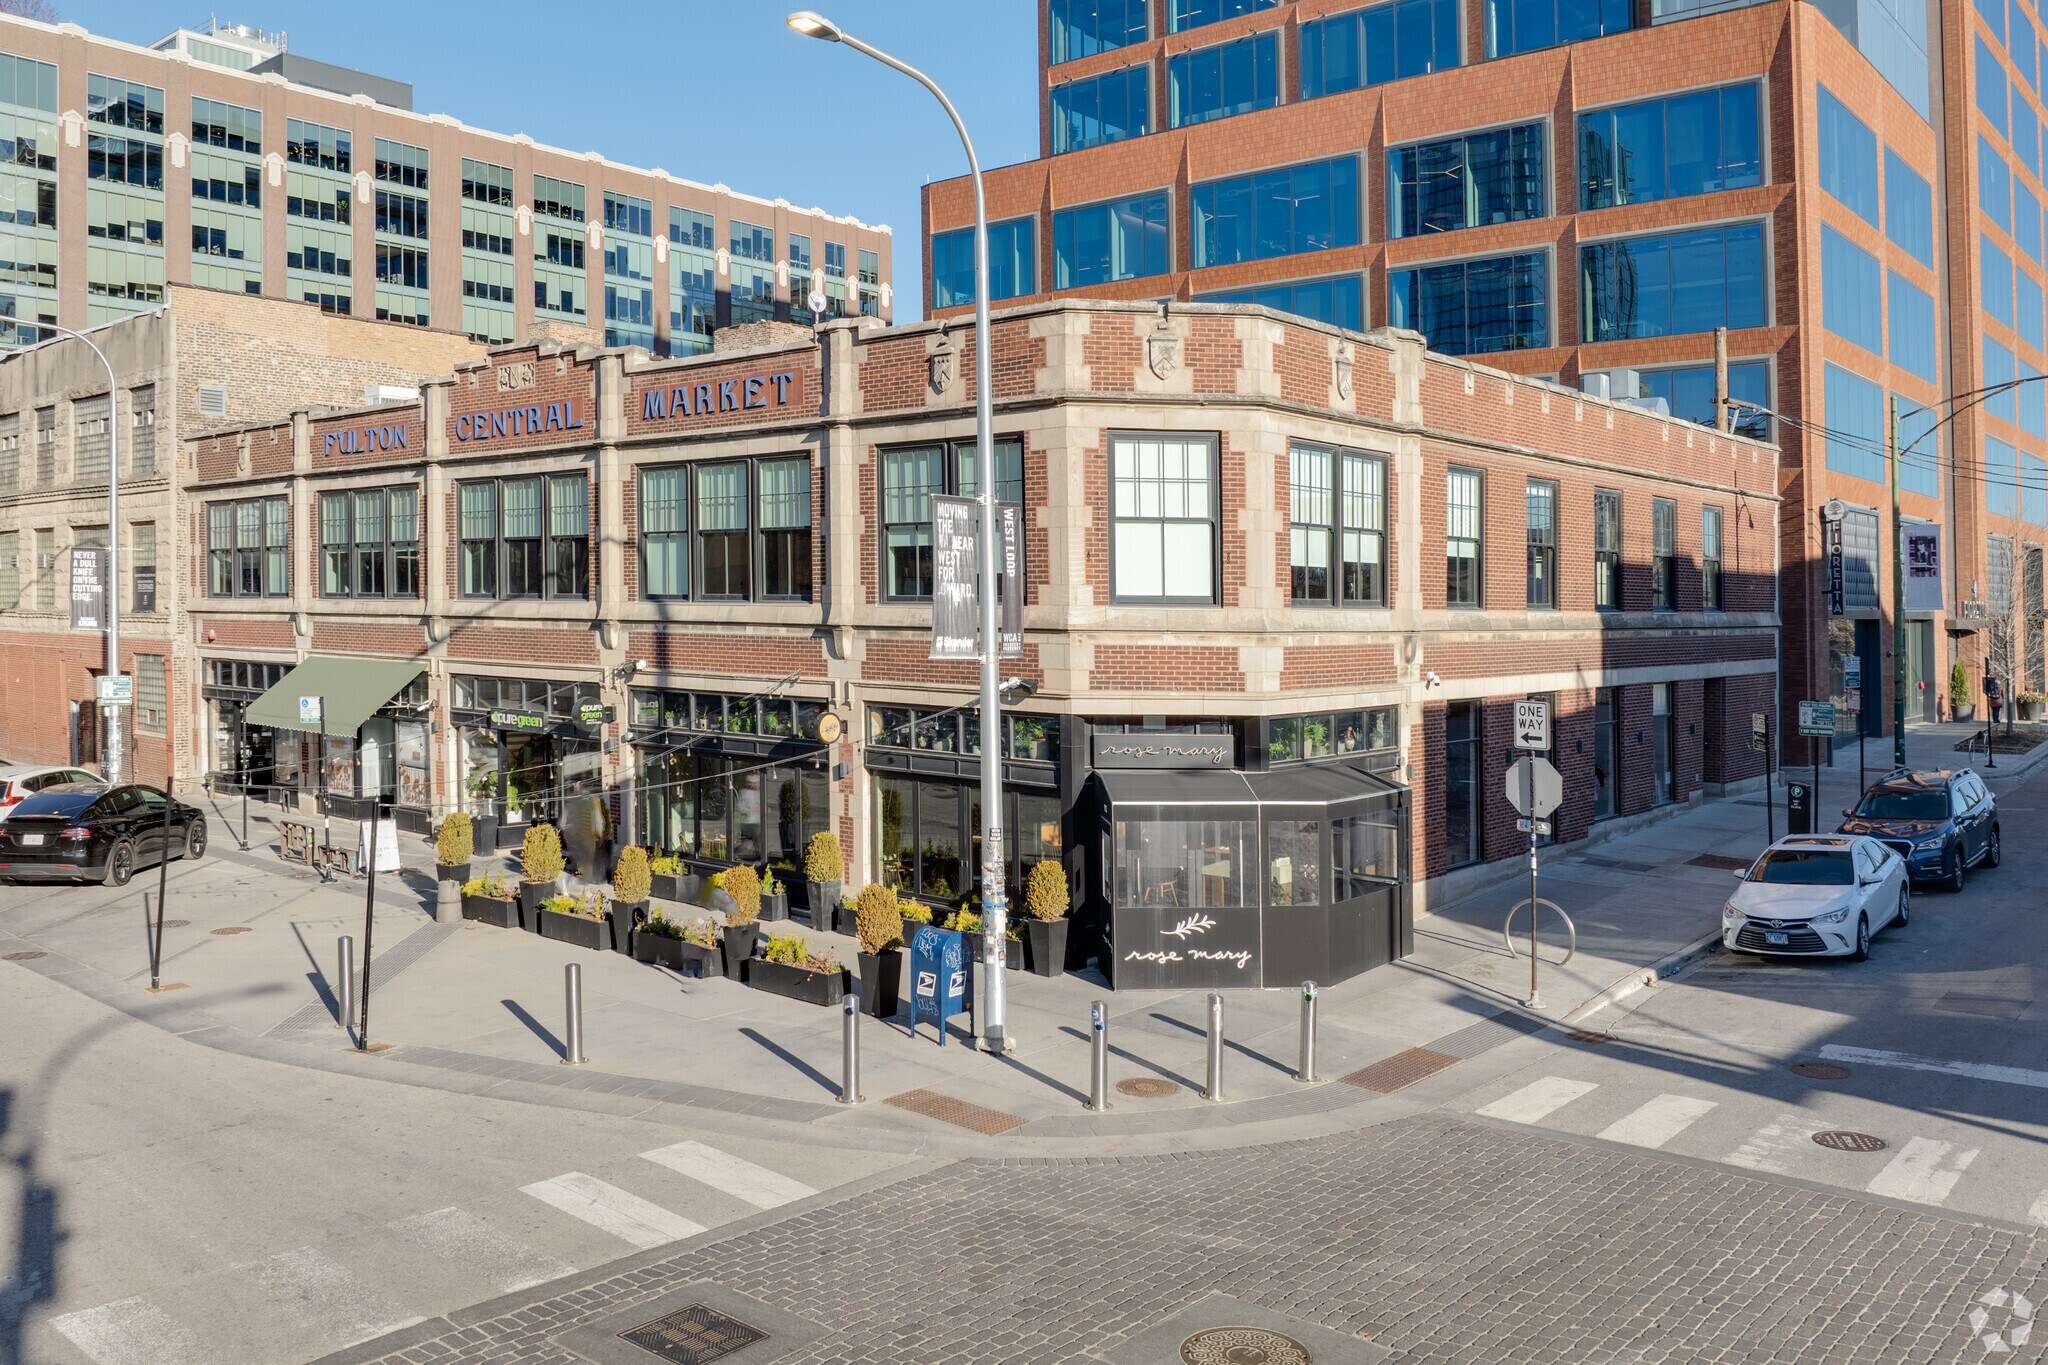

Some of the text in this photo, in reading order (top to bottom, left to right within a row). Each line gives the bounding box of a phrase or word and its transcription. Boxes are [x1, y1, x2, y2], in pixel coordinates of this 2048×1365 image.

[643, 371, 794, 420] MARKET
[456, 401, 584, 442] CENTRAL
[325, 424, 407, 456] FULTON
[937, 503, 968, 519] MOVING
[937, 519, 953, 534] THE
[952, 536, 974, 551] NEAR
[1004, 508, 1016, 577] WEST LOOP
[73, 551, 96, 559] NEVER
[938, 551, 961, 567] WEST
[73, 568, 93, 576] KNIFE
[938, 566, 954, 582] FOR
[1831, 521, 1843, 614] FIORETTA
[73, 585, 102, 593] CUTTING
[1003, 633, 1017, 643] WCA
[585, 704, 602, 712] pure
[1519, 705, 1543, 717] ONE
[581, 711, 602, 721] green
[1518, 718, 1543, 730] WAY
[1100, 746, 1227, 764] rose mary
[1125, 949, 1252, 969] rose mary
